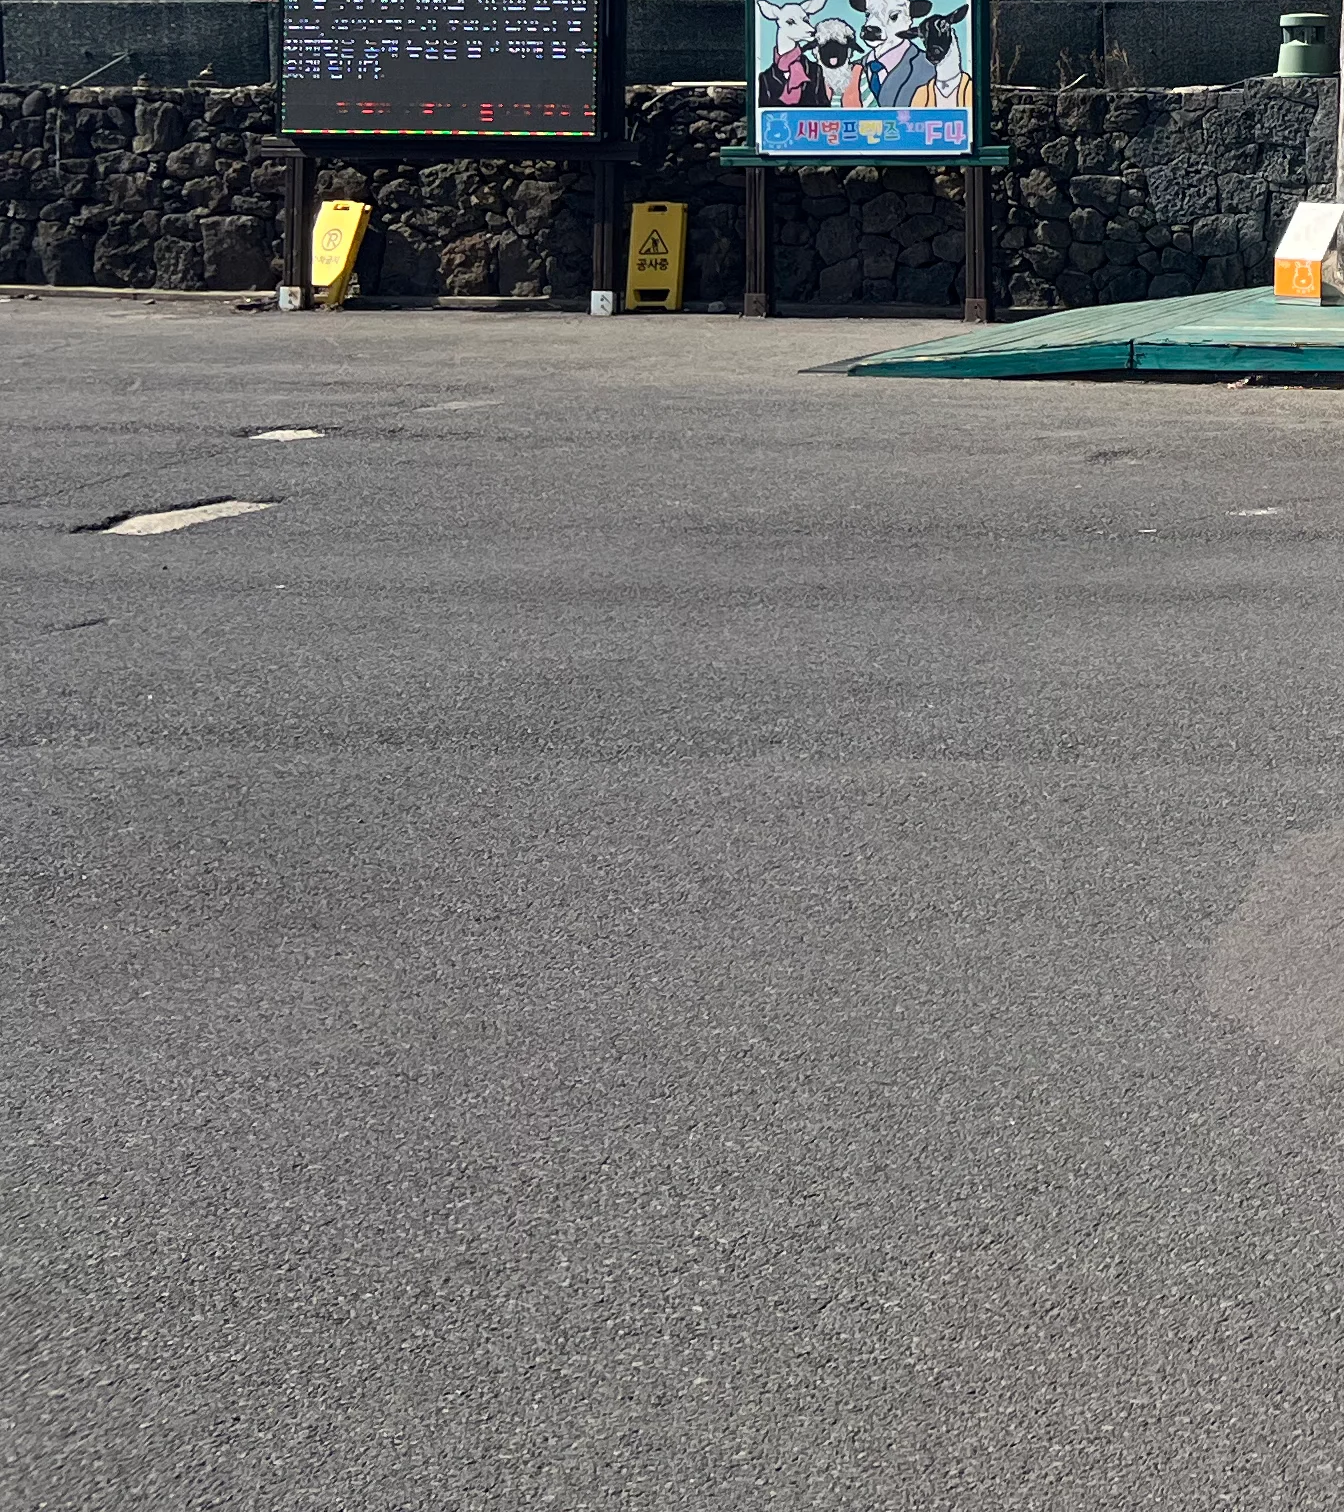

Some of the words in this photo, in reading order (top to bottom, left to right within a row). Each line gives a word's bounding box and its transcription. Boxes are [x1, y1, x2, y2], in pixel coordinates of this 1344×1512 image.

[795, 119, 901, 145] 새별프렌즈
[925, 120, 967, 145] F4
[636, 258, 669, 271] 공사중
